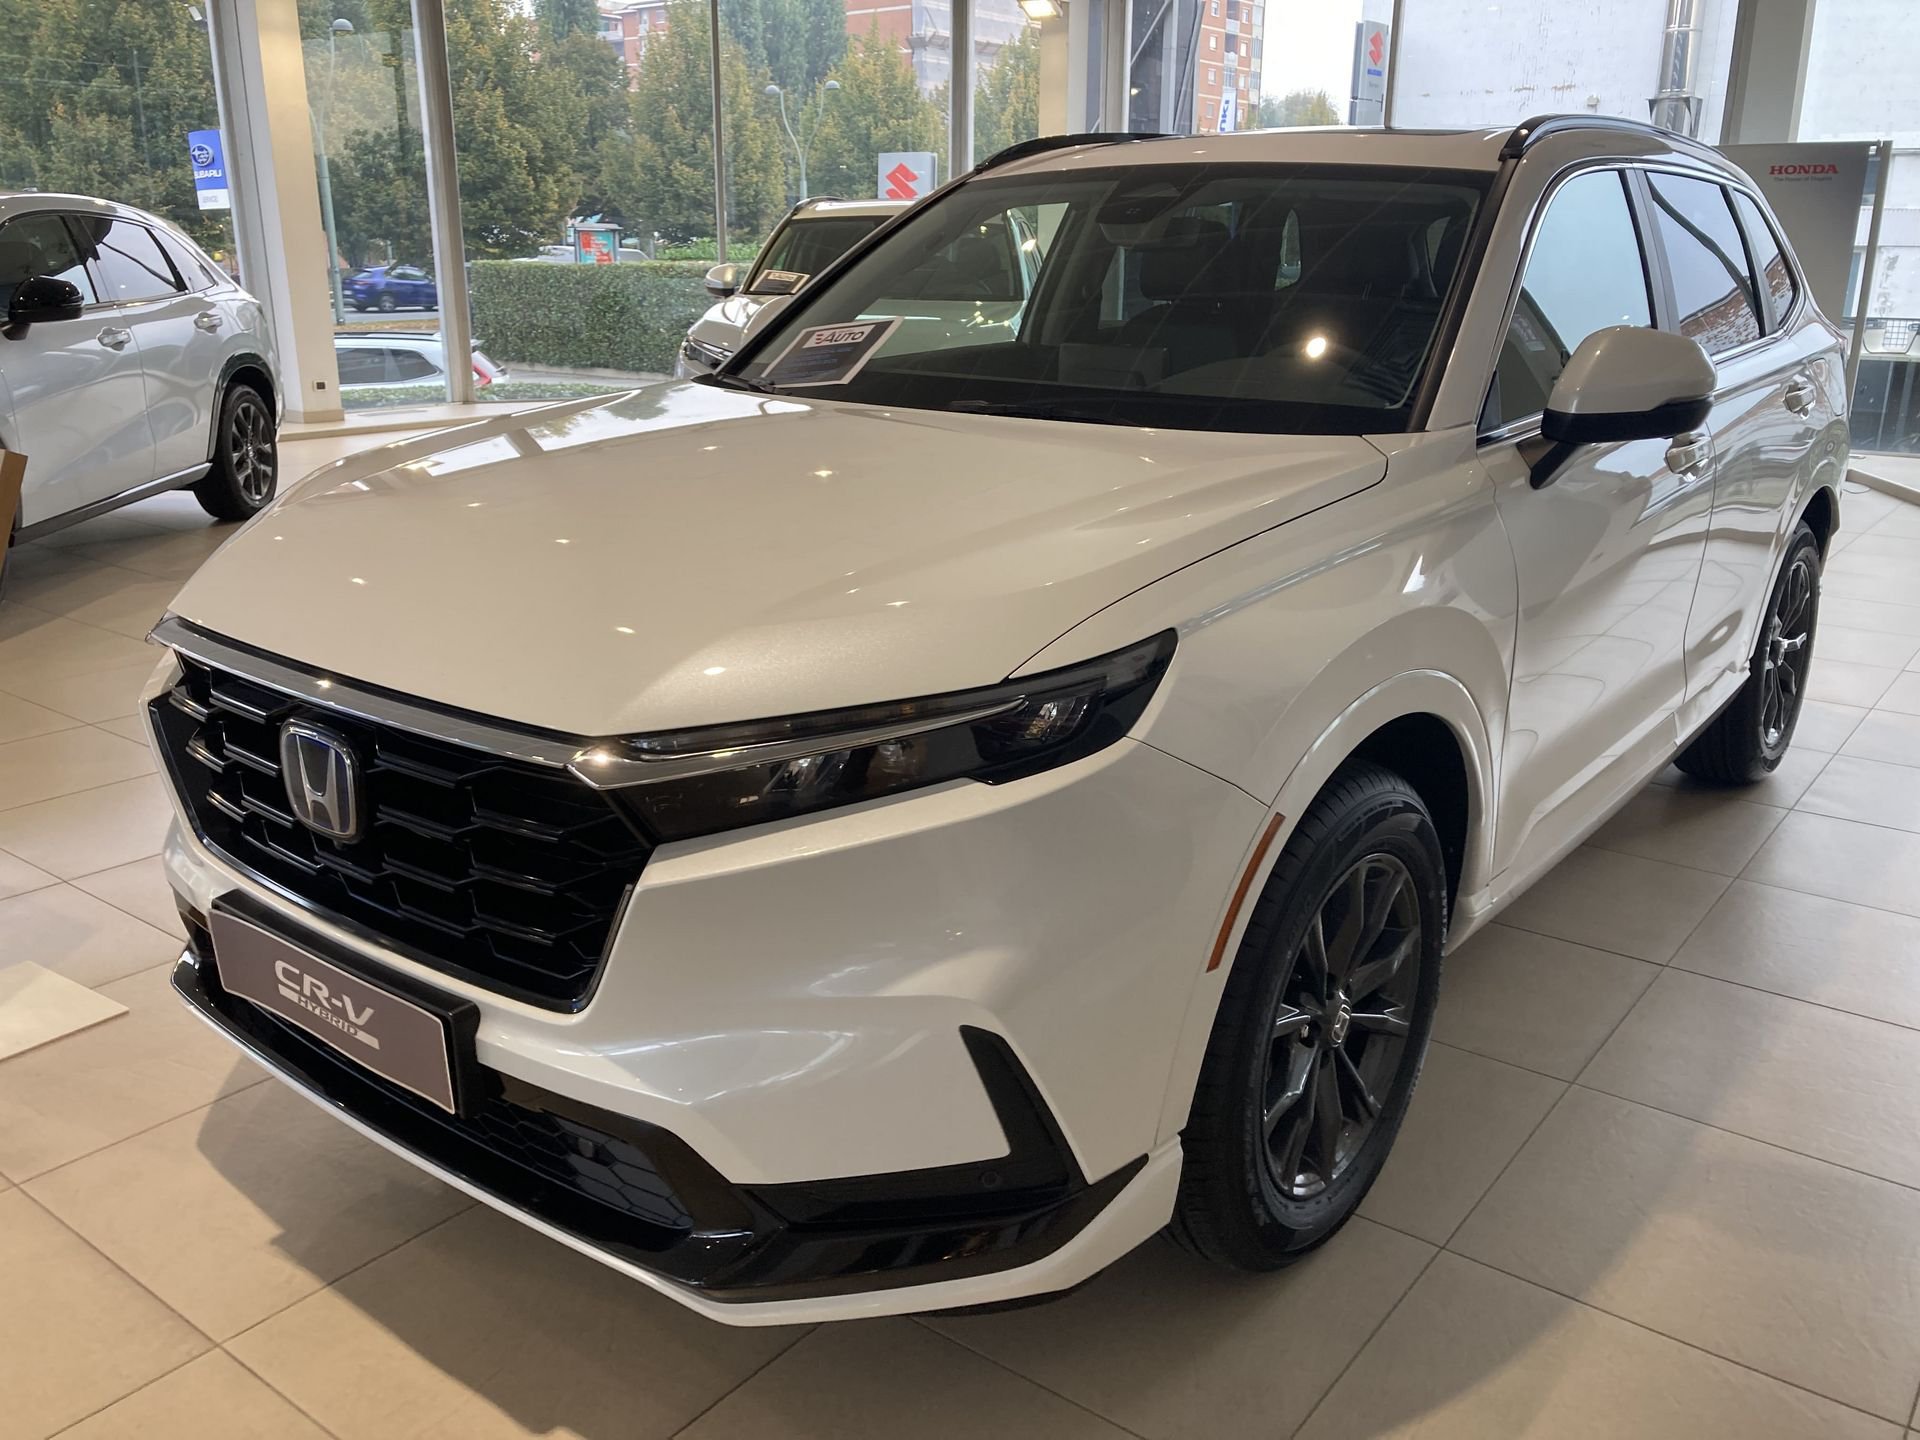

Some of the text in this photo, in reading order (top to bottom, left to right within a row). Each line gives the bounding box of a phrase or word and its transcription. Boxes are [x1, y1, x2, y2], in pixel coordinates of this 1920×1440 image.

[1769, 164, 1839, 175] HONDA
[274, 960, 376, 1026] CR-V
[296, 994, 359, 1037] HYBRID
